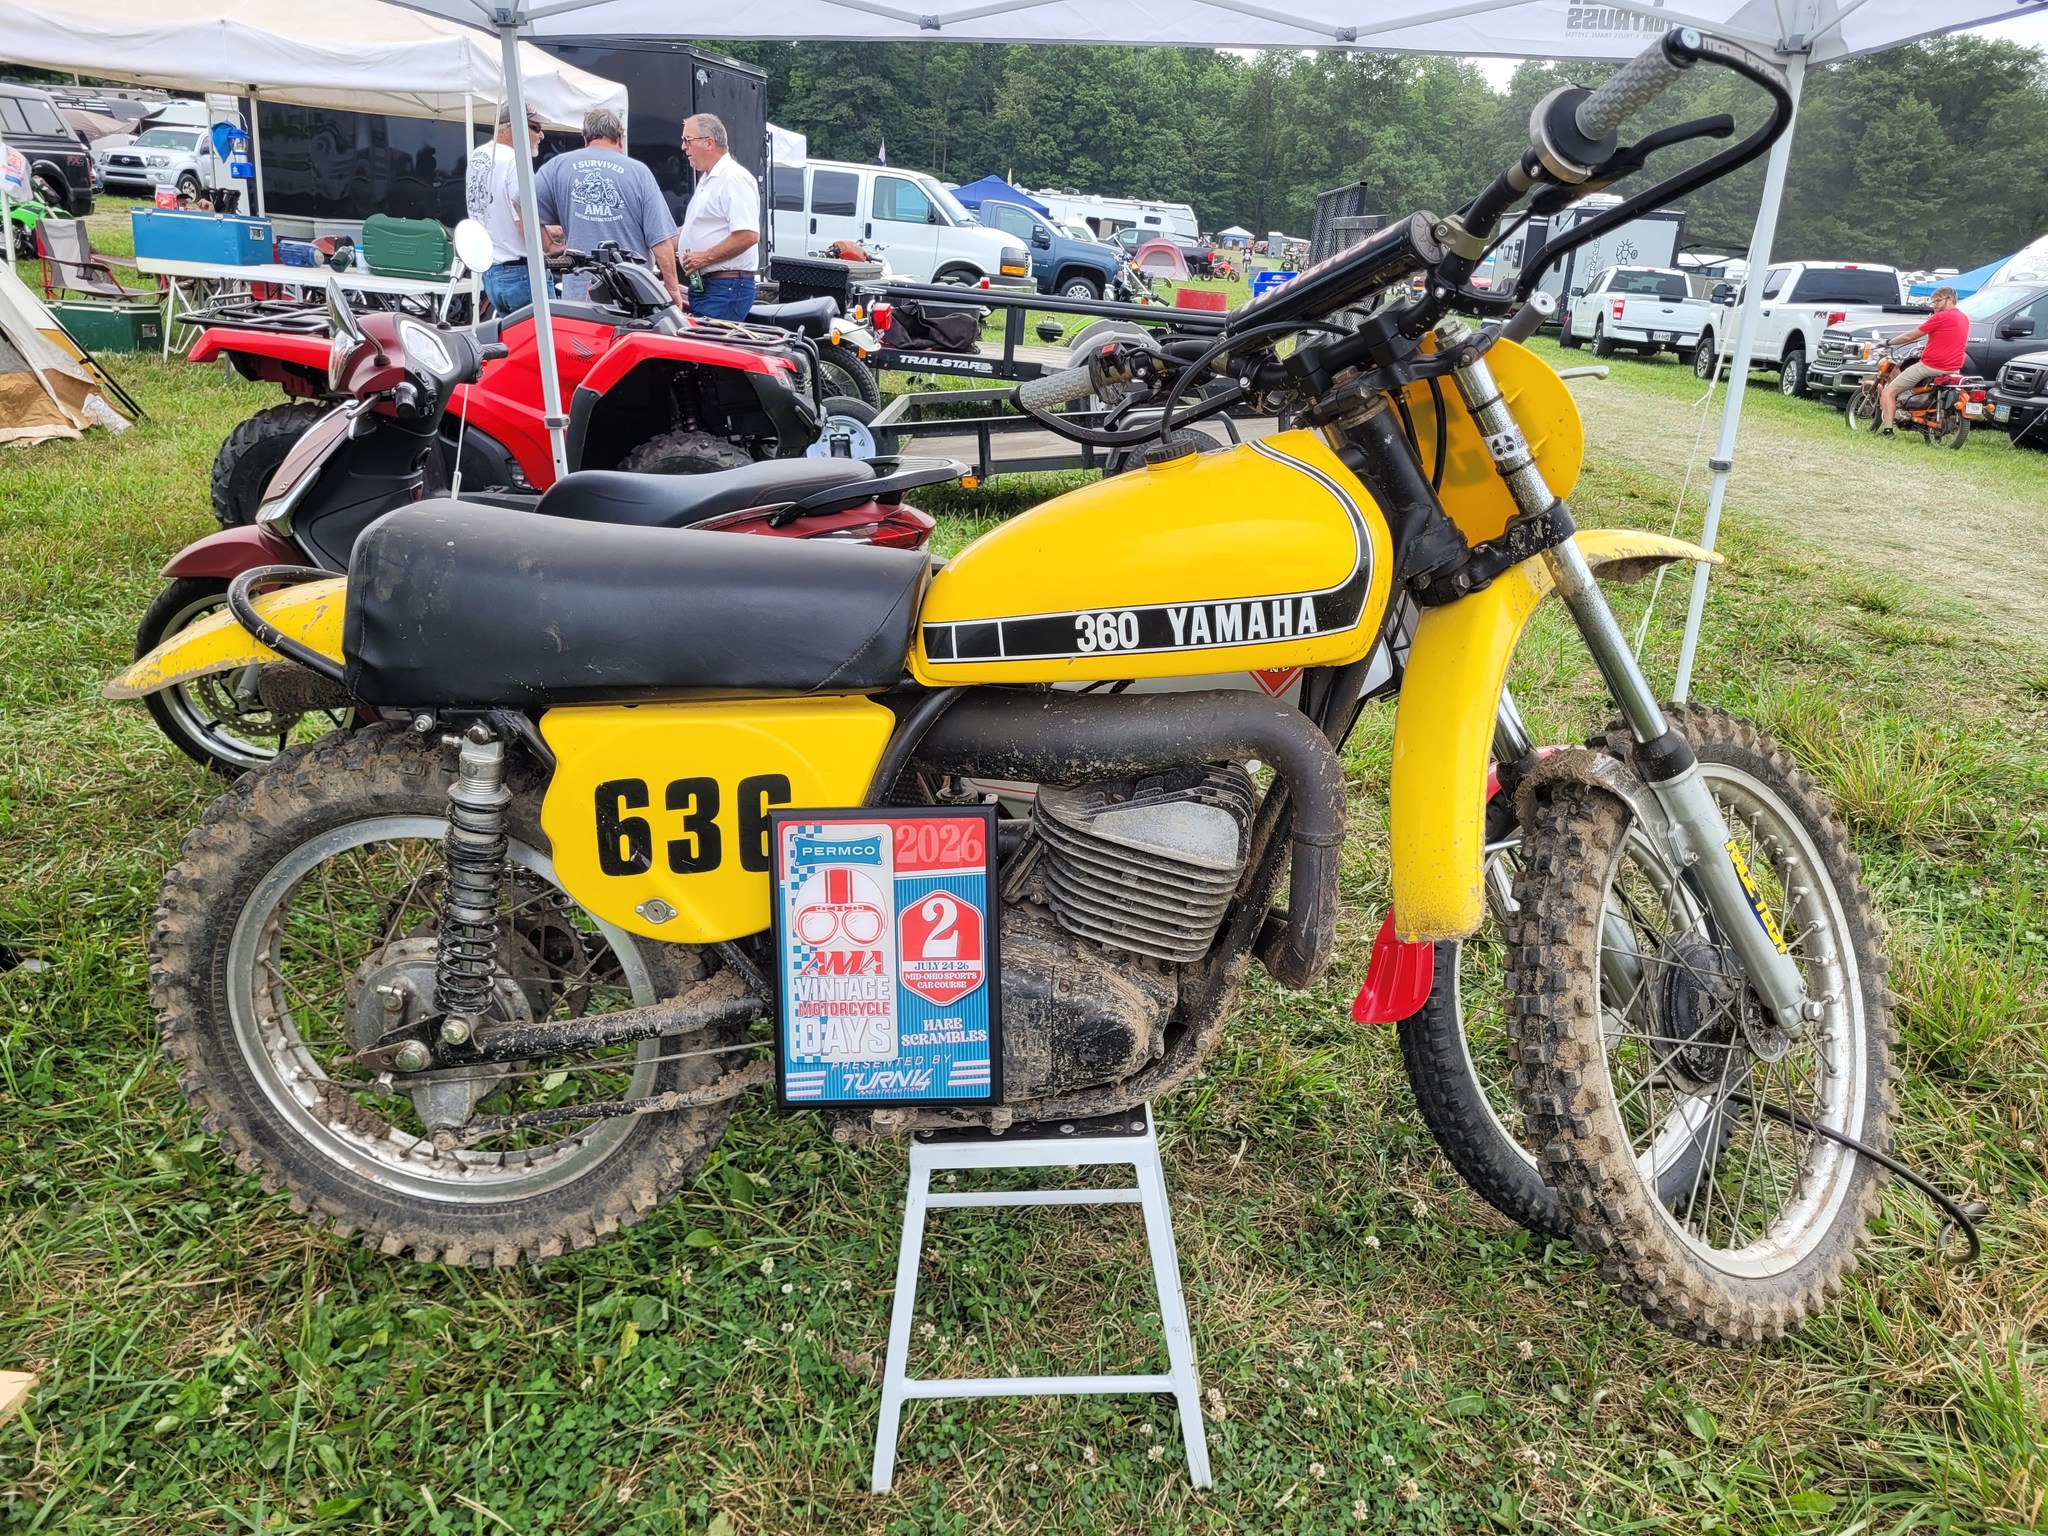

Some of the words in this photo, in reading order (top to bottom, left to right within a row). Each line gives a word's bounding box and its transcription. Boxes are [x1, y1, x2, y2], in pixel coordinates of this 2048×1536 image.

[578, 160, 625, 174] SURVIVED
[584, 204, 613, 216] AMA
[900, 355, 982, 369] TRAILSTAR
[1074, 612, 1140, 652] 360
[1166, 596, 1318, 646] YAMAHA
[594, 774, 792, 877] 636
[802, 846, 876, 856] PERMCO
[895, 824, 983, 864] 2026
[921, 897, 960, 959] 2
[797, 950, 883, 976] AMA
[914, 962, 940, 970] JULY
[942, 962, 969, 970] 24-26
[795, 977, 890, 1001] VINTAGE
[798, 1001, 890, 1016] MOTORCYCLE
[923, 1018, 963, 1031] HARE
[799, 1017, 892, 1054] DAYS
[901, 1030, 987, 1046] SCRAMBLES
[831, 1055, 924, 1071] PRESENTED
[932, 1054, 951, 1065] BY
